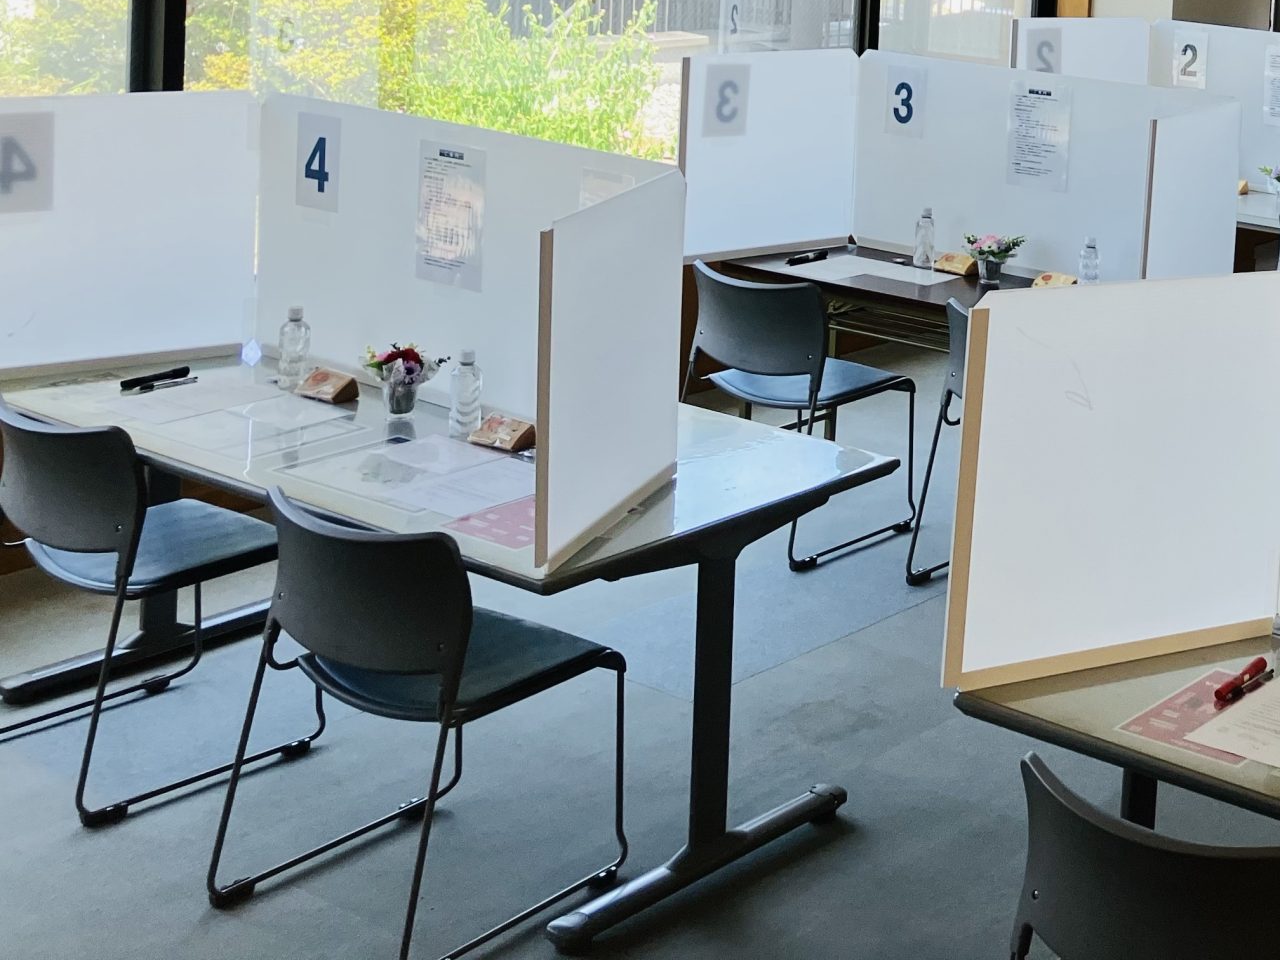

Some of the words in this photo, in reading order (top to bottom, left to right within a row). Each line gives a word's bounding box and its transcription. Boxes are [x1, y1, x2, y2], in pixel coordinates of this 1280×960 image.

[1180, 43, 1198, 77] 2
[893, 81, 915, 124] 3
[304, 136, 330, 193] 4
